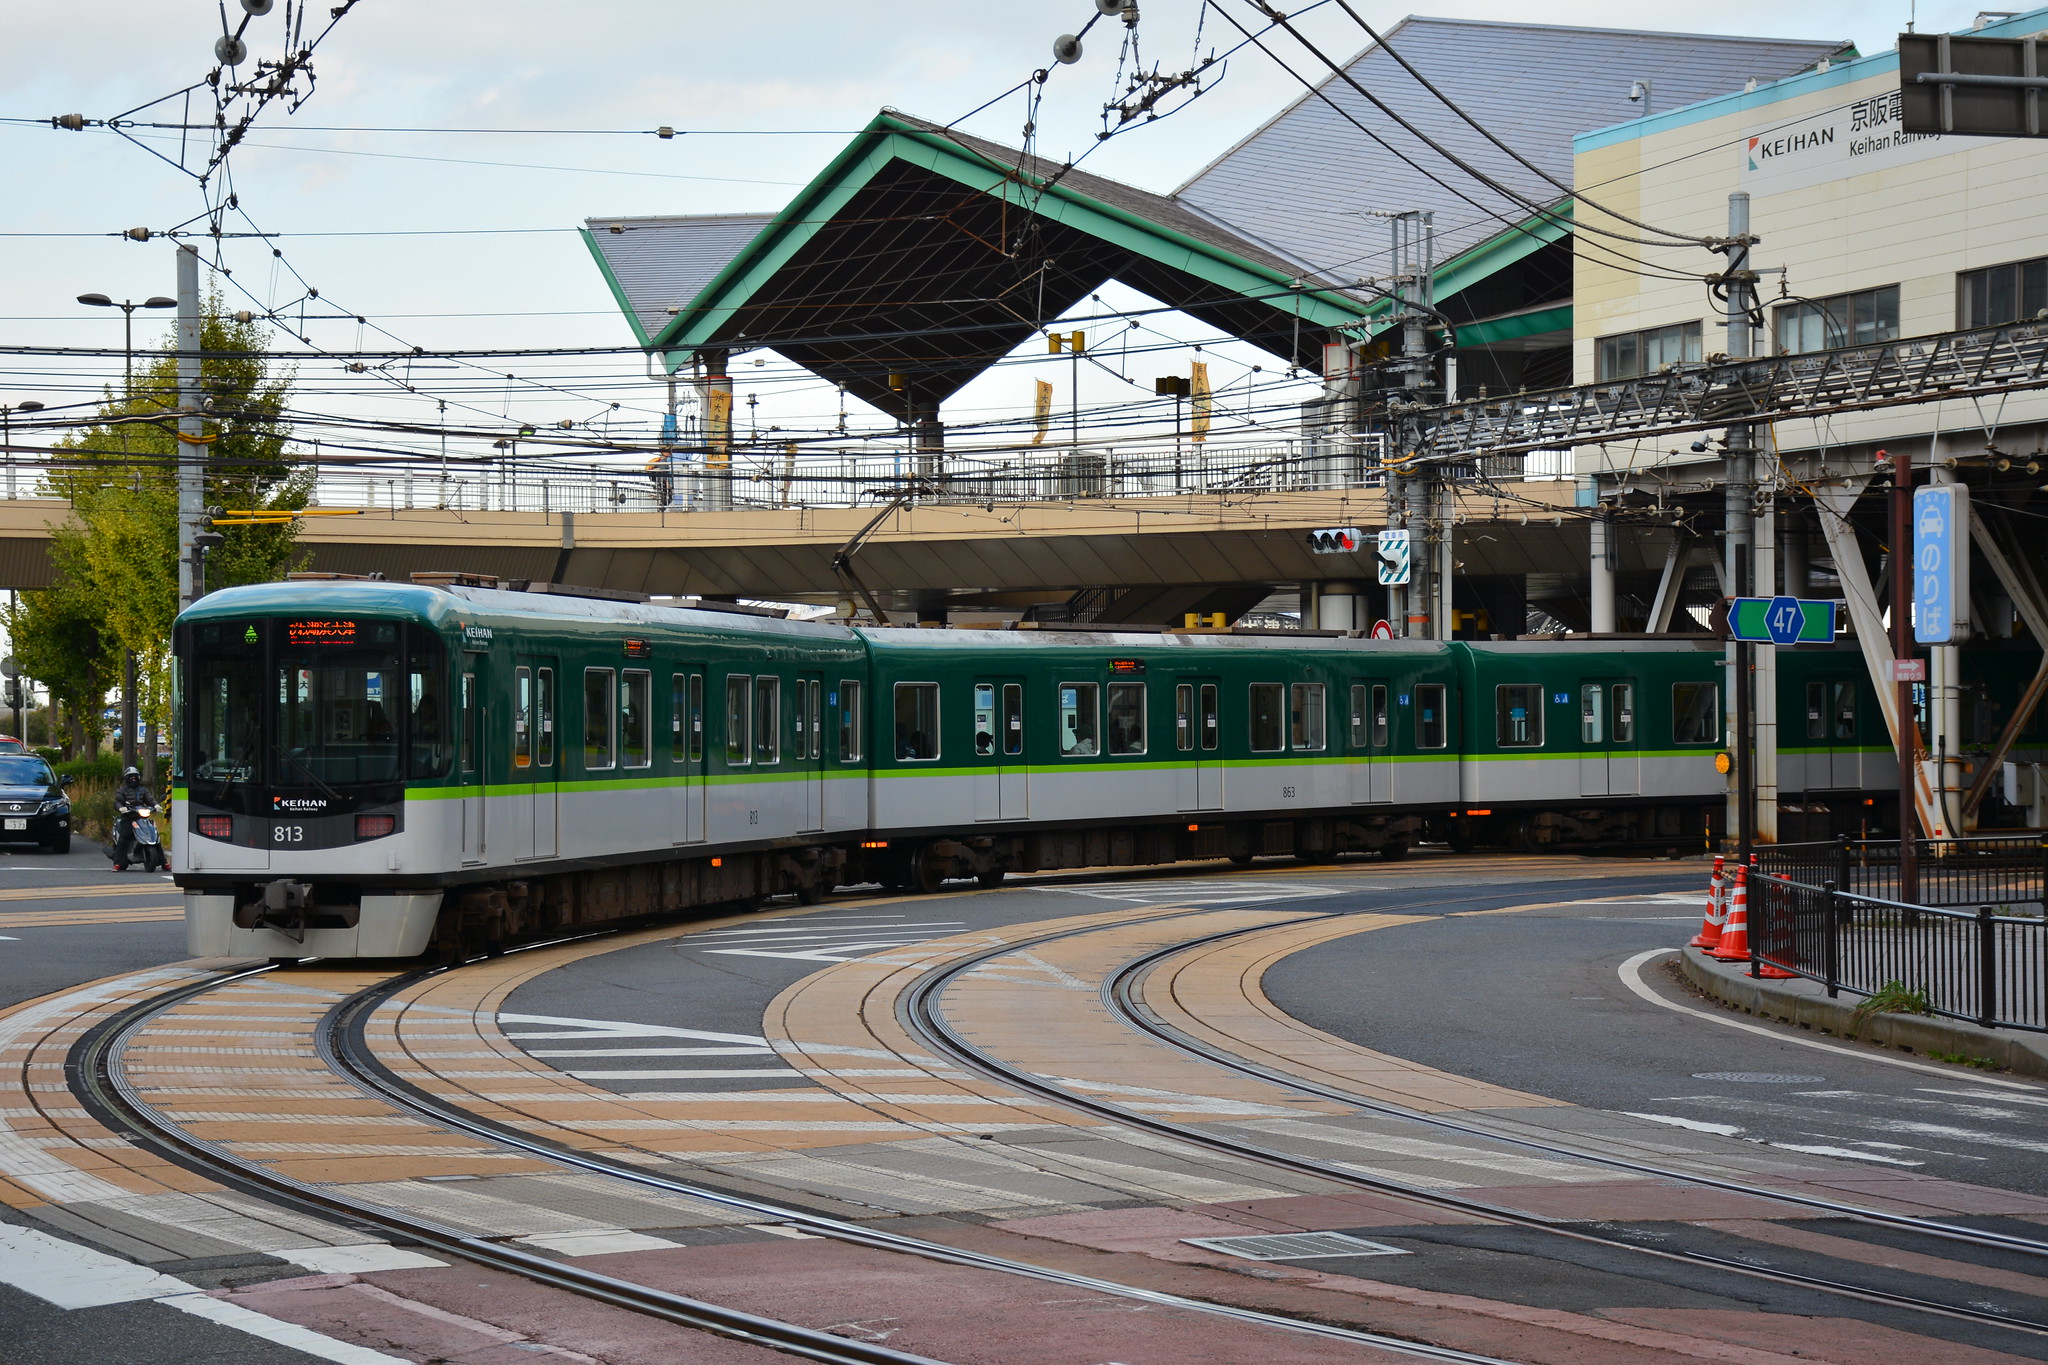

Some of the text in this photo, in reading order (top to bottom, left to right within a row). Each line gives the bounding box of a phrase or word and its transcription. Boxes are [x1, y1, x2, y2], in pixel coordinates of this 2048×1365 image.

[1761, 127, 1834, 159] KEIHAN
[1850, 135, 1890, 156] Keihan
[1917, 494, 1947, 507] TAXI
[1921, 543, 1942, 636] のりば
[1773, 606, 1797, 634] 47
[465, 626, 493, 639] KEIHAN
[1282, 786, 1296, 798] 863
[281, 799, 327, 807] KEIHAN
[274, 826, 303, 842] 813
